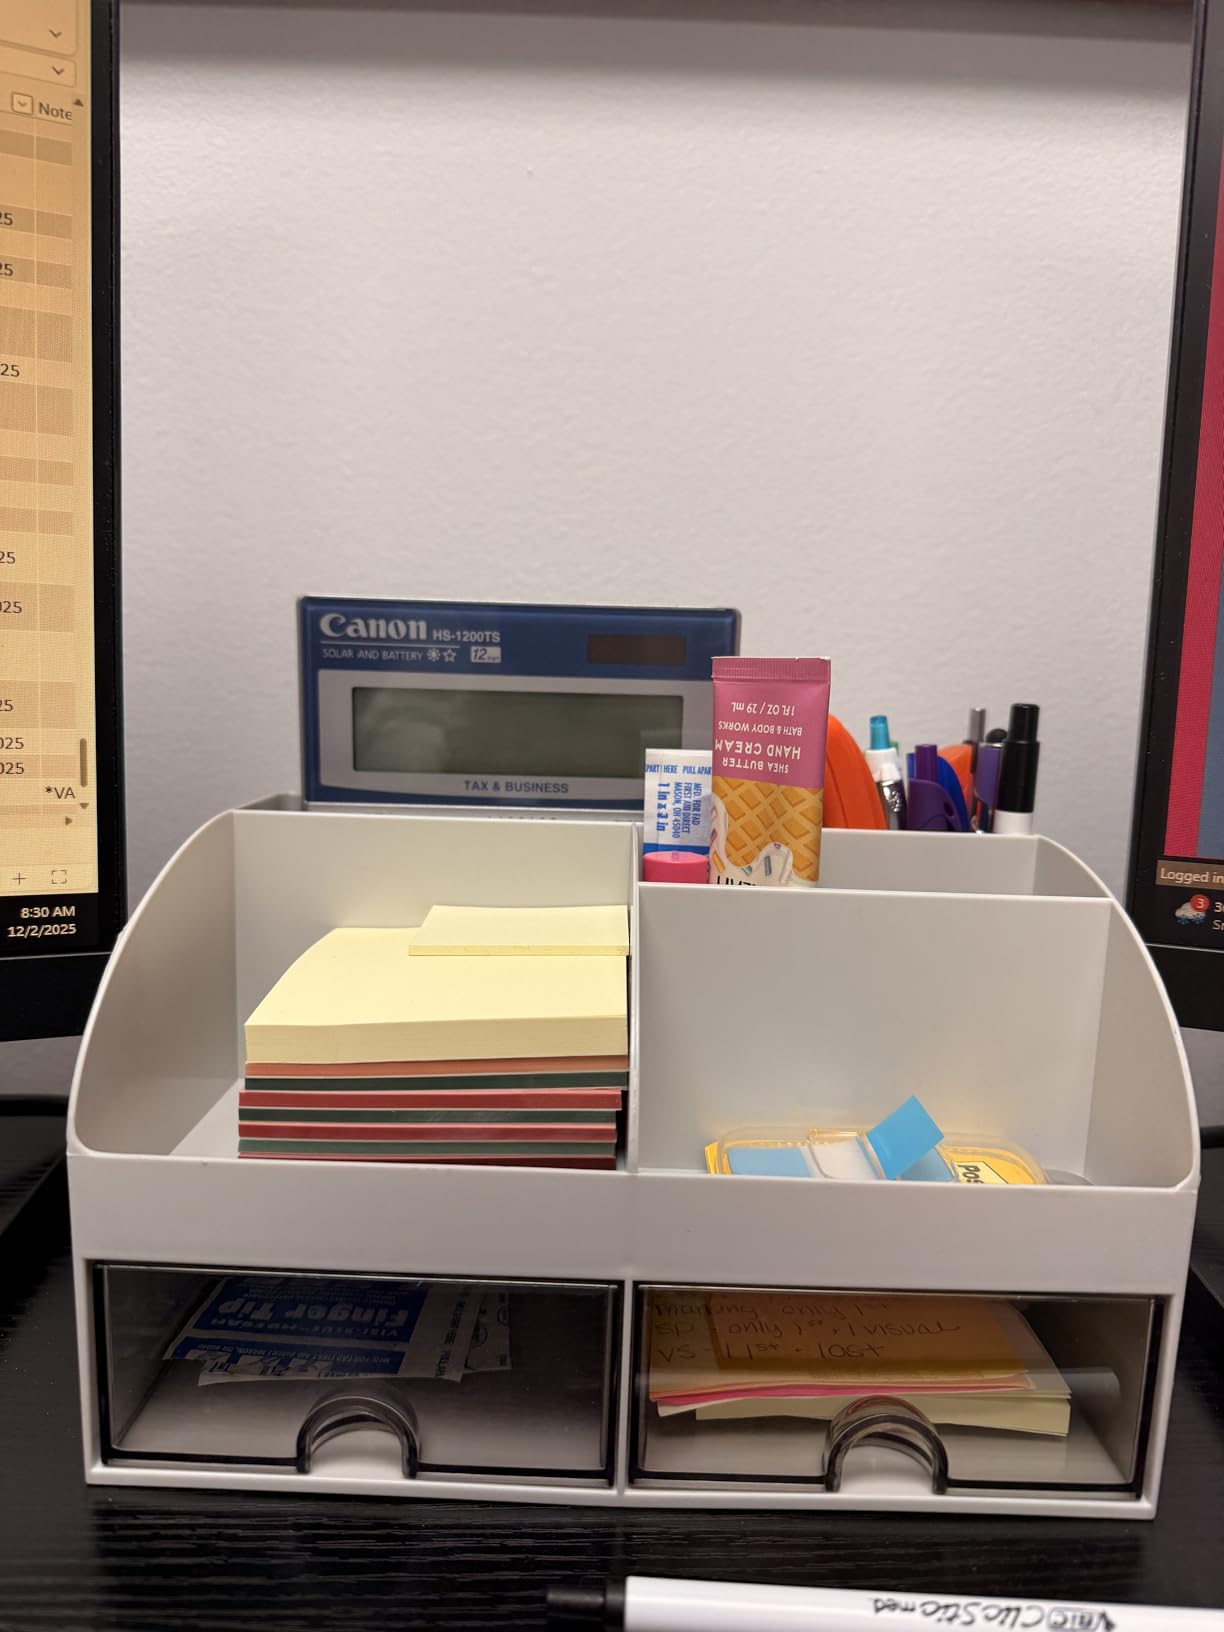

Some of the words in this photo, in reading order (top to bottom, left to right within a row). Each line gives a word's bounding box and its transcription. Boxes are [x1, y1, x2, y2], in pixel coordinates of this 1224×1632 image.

[0, 363, 20, 378] 25
[319, 612, 428, 641] Canon
[432, 629, 501, 644] HS-1200TS
[321, 647, 354, 659] SOLAR
[357, 649, 380, 660] AND
[383, 650, 424, 662] BATTERY
[731, 702, 745, 713] mL
[746, 703, 758, 714] 29
[767, 704, 780, 716] OZ
[781, 705, 791, 716] FL
[718, 720, 750, 732] WORKS
[752, 723, 775, 735] BODY
[776, 725, 782, 735] &
[783, 726, 803, 737] BATH
[714, 738, 762, 756] CREAM
[766, 743, 801, 760] HAND
[645, 763, 660, 774] PART
[664, 764, 678, 774] HERE
[682, 765, 696, 775] PULL
[722, 756, 764, 771] BUTTER
[767, 761, 789, 774] SHEA
[464, 780, 489, 792] TAX
[492, 781, 501, 792] &
[505, 781, 569, 794] BUSINESS
[672, 782, 683, 806] MASON,
[683, 782, 693, 799] FIRST
[657, 791, 670, 801] in
[682, 800, 692, 811] AID
[692, 799, 702, 813] FOR
[681, 812, 691, 834] DIRECT
[691, 813, 701, 826] FAD
[656, 822, 669, 832] in
[1160, 867, 1209, 884] Logged
[1196, 898, 1205, 909] 3
[1214, 901, 1224, 913] 3
[21, 906, 50, 919] 8:30
[52, 905, 76, 917] AM
[7, 923, 77, 939] 12/2/2025
[217, 1297, 275, 1321] Tip
[284, 1302, 408, 1328] Finger
[817, 1341, 886, 1362] last
